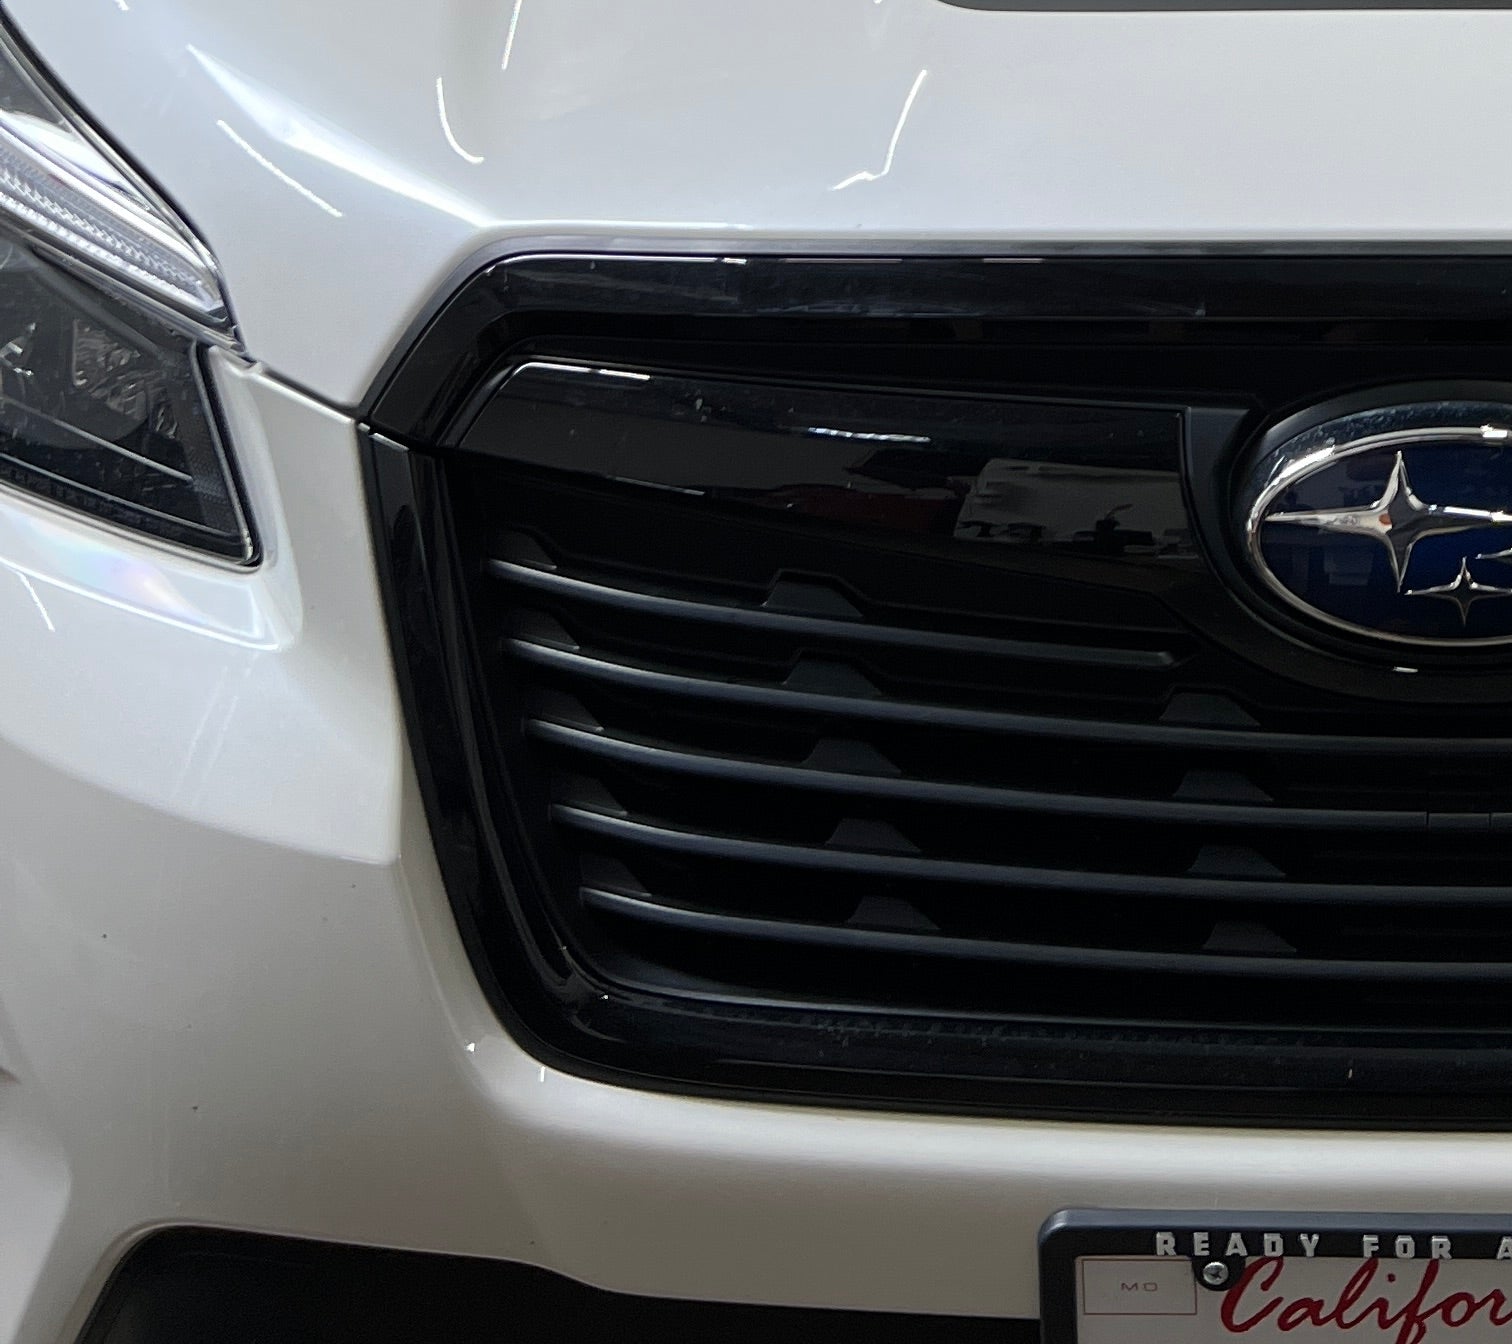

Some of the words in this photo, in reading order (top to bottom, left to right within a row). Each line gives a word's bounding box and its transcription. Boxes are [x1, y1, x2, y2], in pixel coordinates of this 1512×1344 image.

[1155, 1231, 1320, 1257] READY
[1362, 1234, 1452, 1260] FOR
[1120, 1282, 1159, 1293] MO
